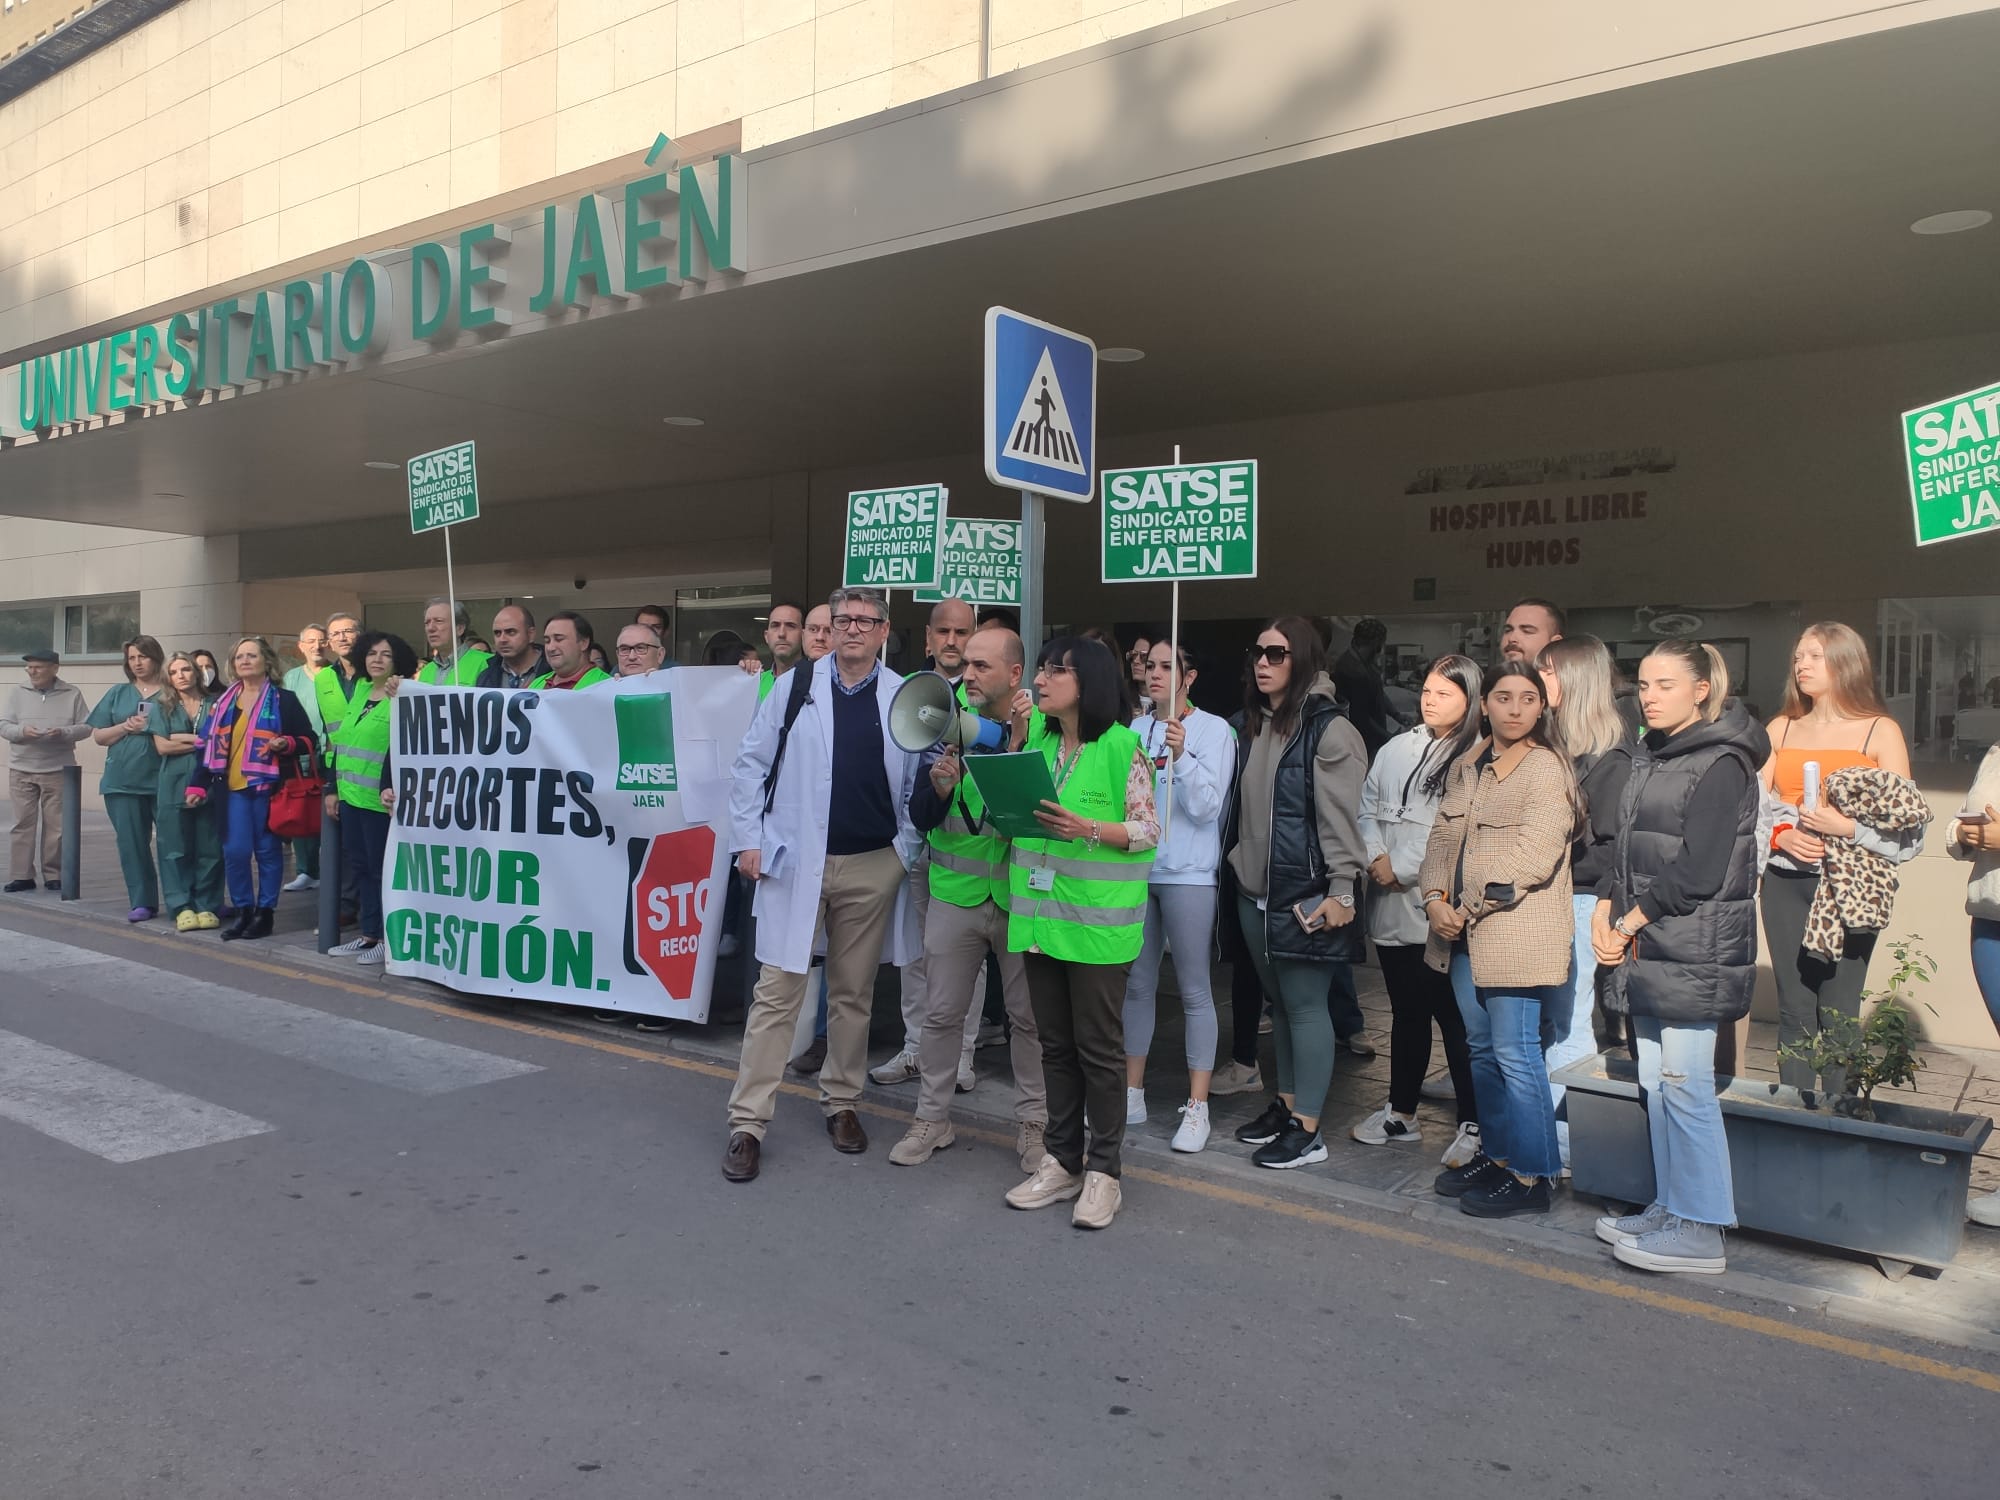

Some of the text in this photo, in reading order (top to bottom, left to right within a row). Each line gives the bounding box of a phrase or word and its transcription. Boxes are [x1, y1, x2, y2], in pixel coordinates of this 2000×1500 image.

[20, 132, 733, 431] UNIVERSITARIO DE JAÉN
[1914, 391, 2000, 457] SAT
[411, 446, 471, 486] SATSE
[1918, 441, 2000, 480] SINDIC
[412, 472, 473, 498] SINDICATO DE
[413, 485, 474, 510] ENFERMERIA
[1109, 466, 1249, 511] SATSE
[1920, 465, 2000, 501] ENFER
[425, 498, 465, 526] JAEN
[851, 490, 937, 527] SATSE
[1109, 506, 1247, 530] SINDICATO DE
[1429, 490, 1649, 533] HOSPITAL LIBRE
[1951, 489, 2000, 530] JA
[850, 540, 932, 557] ENFERMERIA
[851, 524, 933, 543] SINDICATO DE
[944, 521, 1022, 551] ATS
[1110, 525, 1248, 547] ENFERMERIA
[942, 550, 1022, 566] NDICATO D
[1132, 544, 1223, 576] JAEN
[1486, 537, 1581, 569] HUMOS
[862, 557, 917, 582] JAEN
[940, 577, 1016, 601] JAEN
[399, 690, 541, 756] MENOS
[619, 763, 676, 785] SATSE
[396, 766, 616, 847] RECORTES,
[391, 841, 541, 906] MEJOR
[647, 878, 711, 932] STO
[385, 908, 611, 992] GESTIÓN.
[660, 934, 700, 958] RECO
